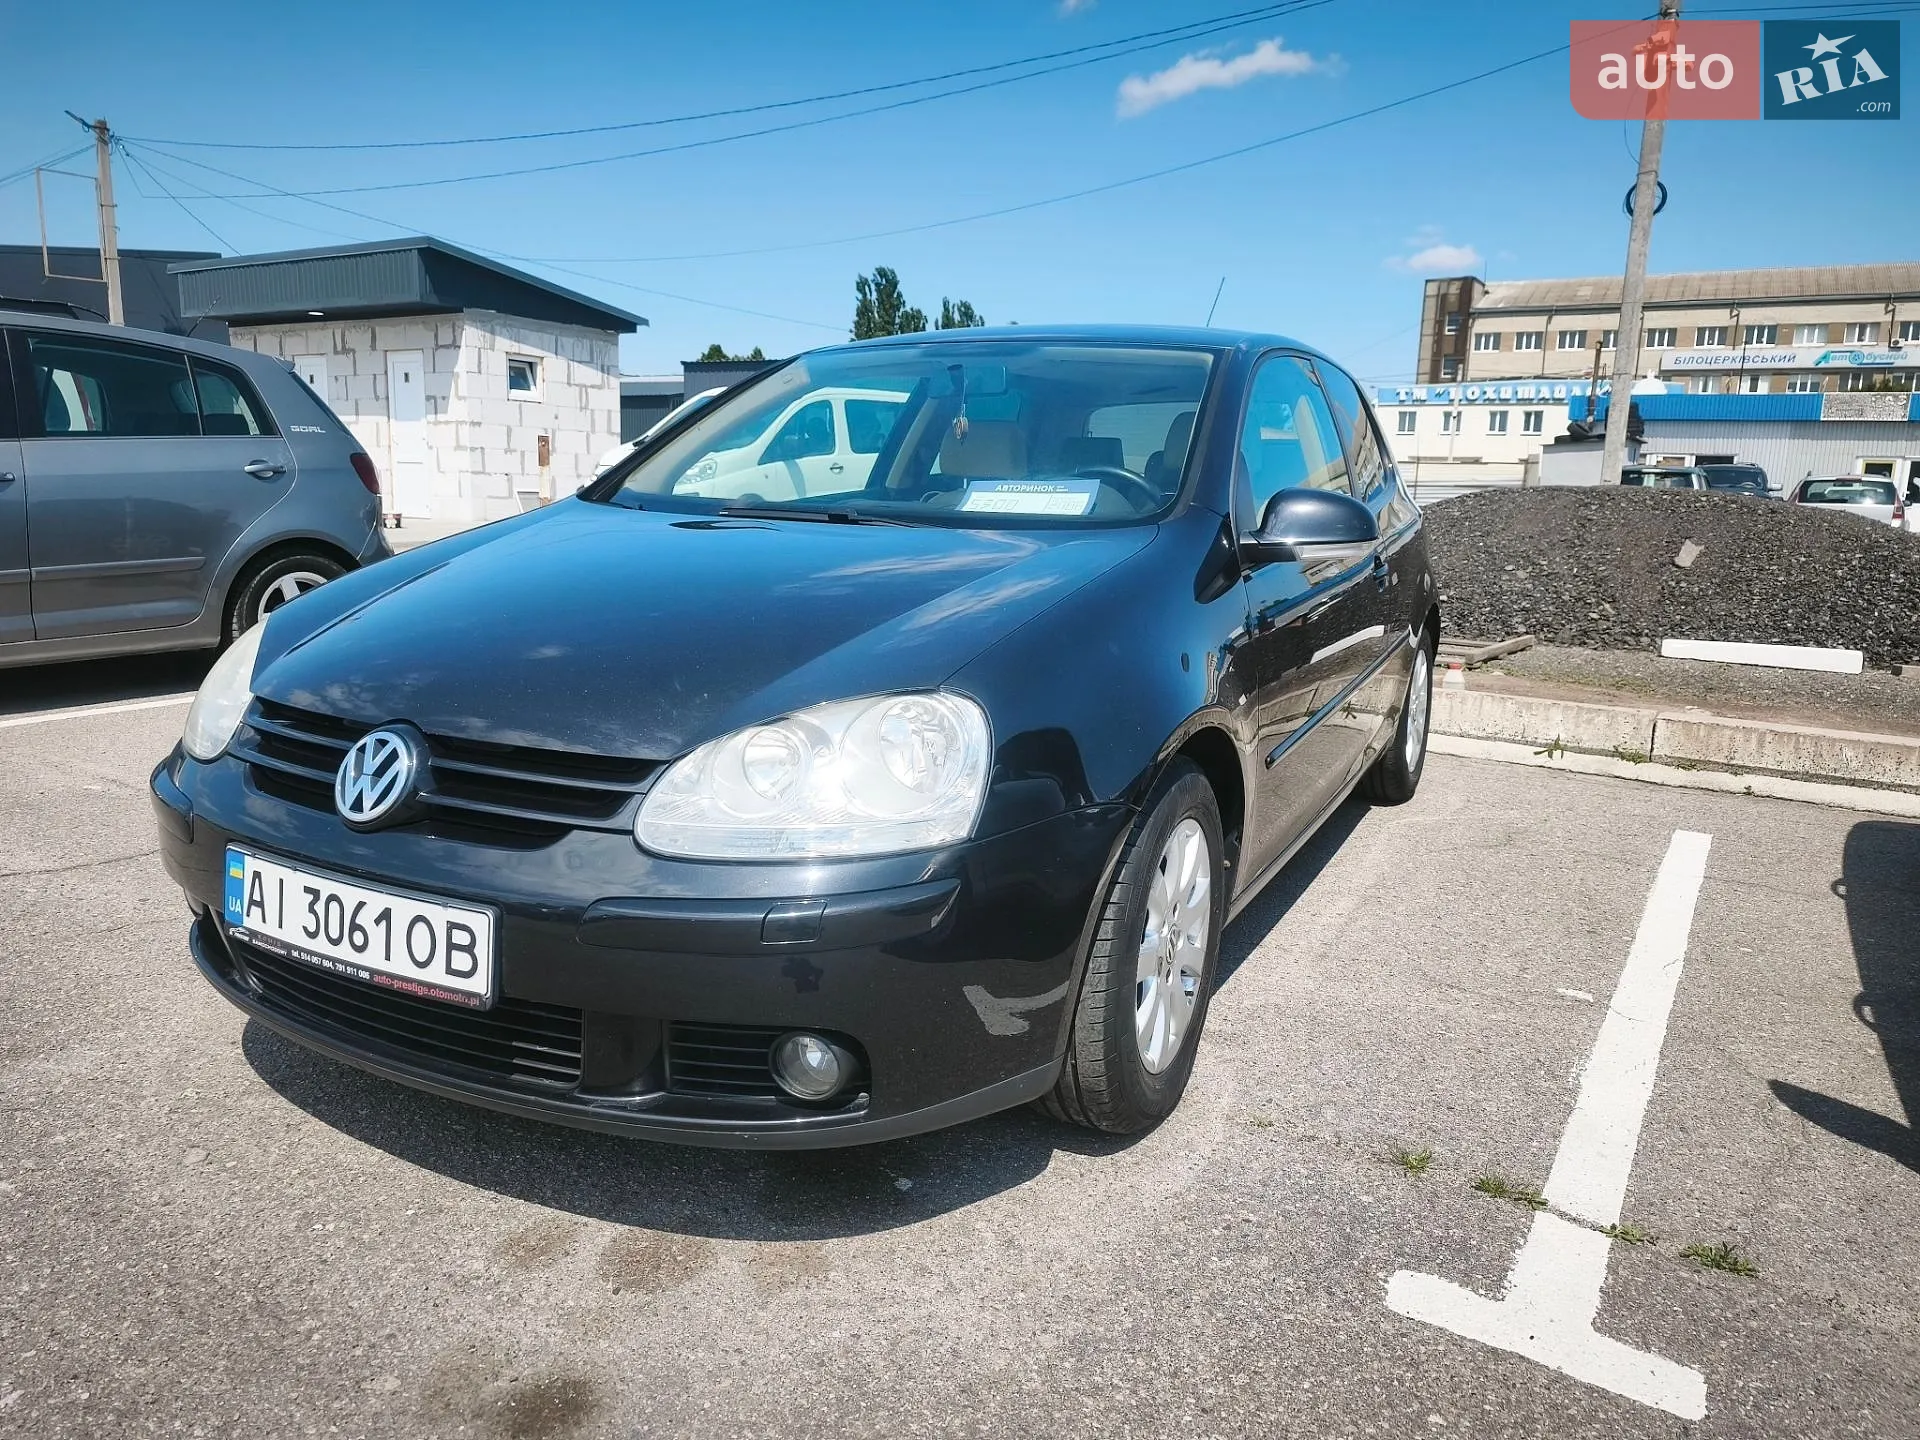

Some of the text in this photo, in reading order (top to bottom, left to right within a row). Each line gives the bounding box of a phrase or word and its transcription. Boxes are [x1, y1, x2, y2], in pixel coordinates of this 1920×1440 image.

[1674, 355, 1796, 365] БІЛОЦЕРКІВСЬКИЙ
[1396, 388, 1428, 401] ТМ
[290, 425, 326, 433] GOAL
[994, 484, 1054, 493] АВТОРИНОК
[228, 895, 242, 915] UA
[245, 870, 479, 979] AI 3061 OB
